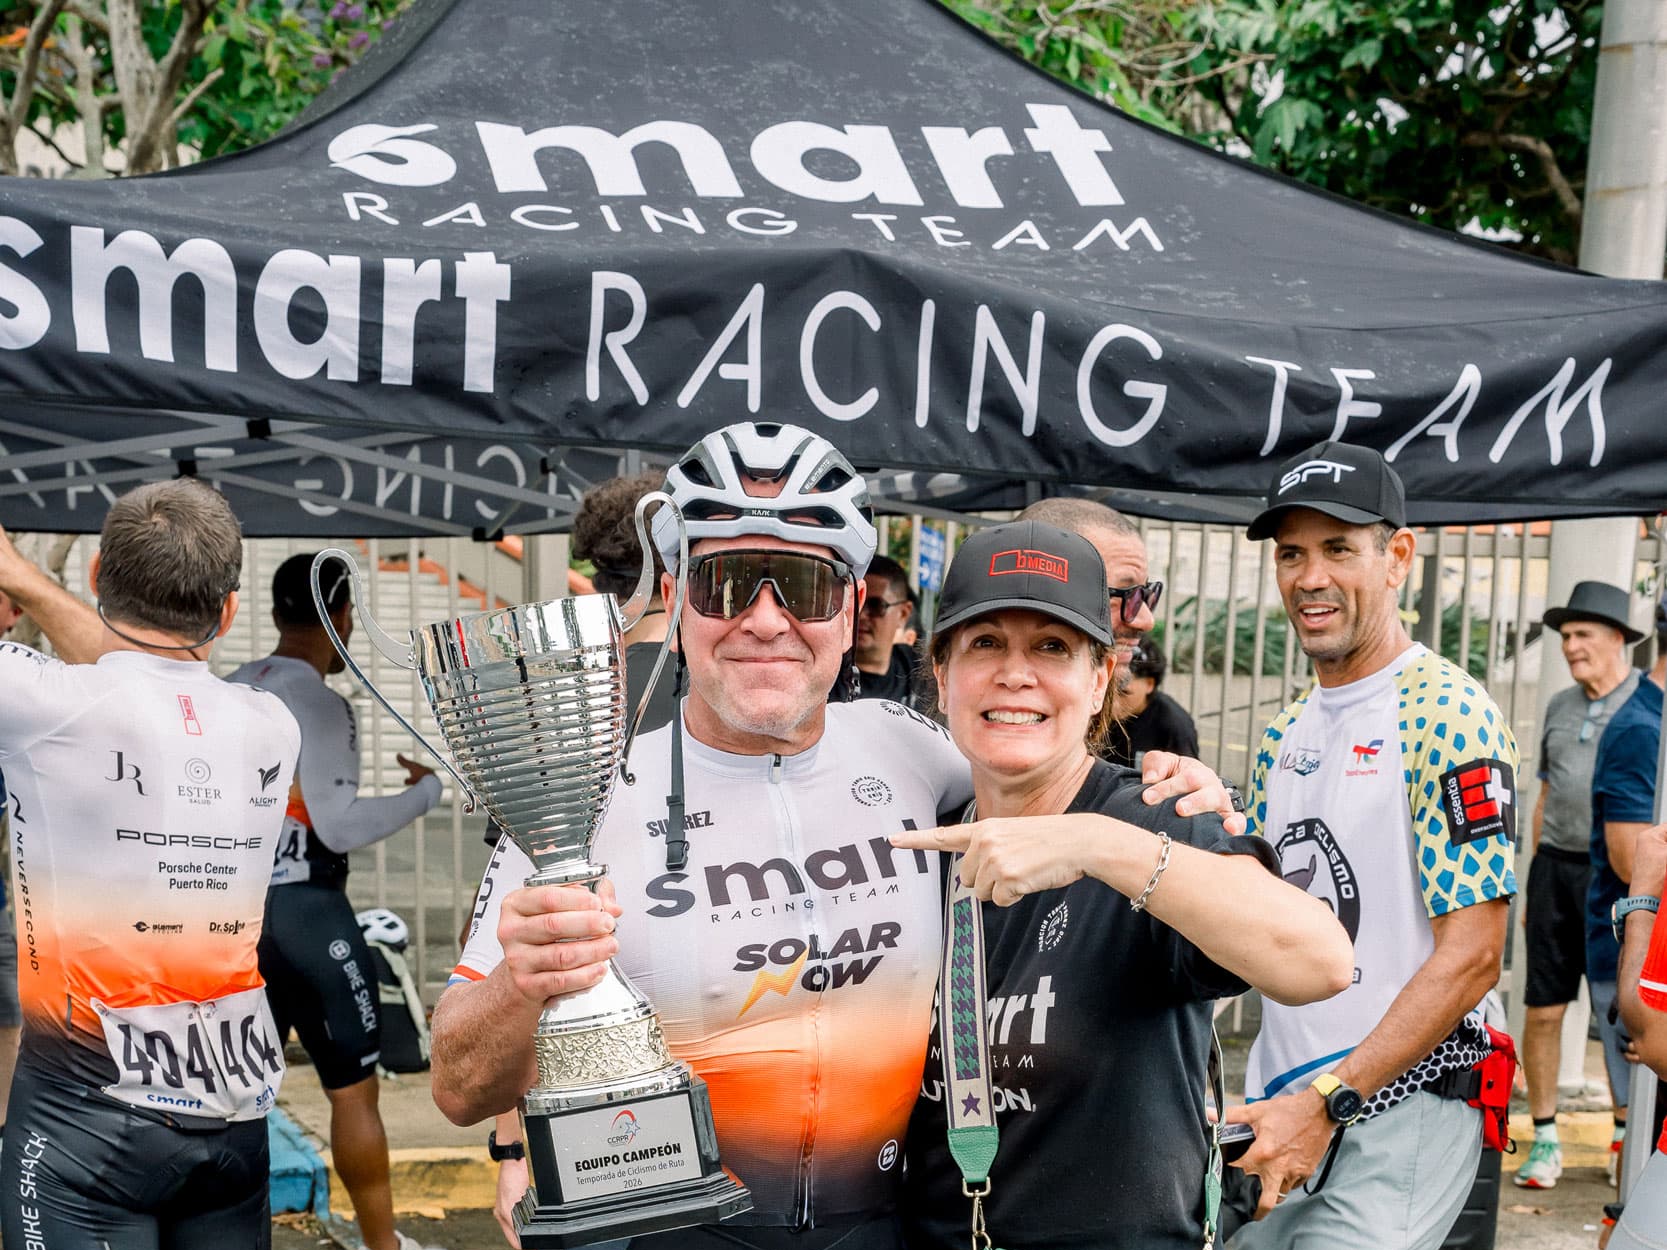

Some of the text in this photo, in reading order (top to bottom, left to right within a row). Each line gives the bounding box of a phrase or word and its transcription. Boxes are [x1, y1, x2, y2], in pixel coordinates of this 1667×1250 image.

[328, 103, 1125, 210] smart
[343, 190, 1165, 252] RACING TEAM
[0, 215, 1613, 468] smart RACING TEAM
[1278, 459, 1356, 496] SPT
[177, 785, 222, 800] ESTER
[249, 796, 278, 805] ALIGHT
[1447, 776, 1465, 826] essentia
[116, 828, 263, 850] PORSCHE
[646, 810, 715, 838] SUREZ
[158, 861, 238, 875] Porsche Center
[169, 878, 228, 891] Puerto Rico
[15, 831, 40, 972] NEVERSECOND
[711, 884, 900, 924] RACING TEAM
[733, 921, 902, 972] SOLAR
[342, 959, 366, 993] BIKE
[354, 989, 377, 1033] SHACK
[992, 1053, 1034, 1069] EAM
[146, 1093, 204, 1110] smart
[20, 1131, 48, 1200] SHACK
[574, 1141, 682, 1172] EQUIPO CAMPEÓN
[576, 1159, 685, 1186] Temporada de Ciclismo de Ruta
